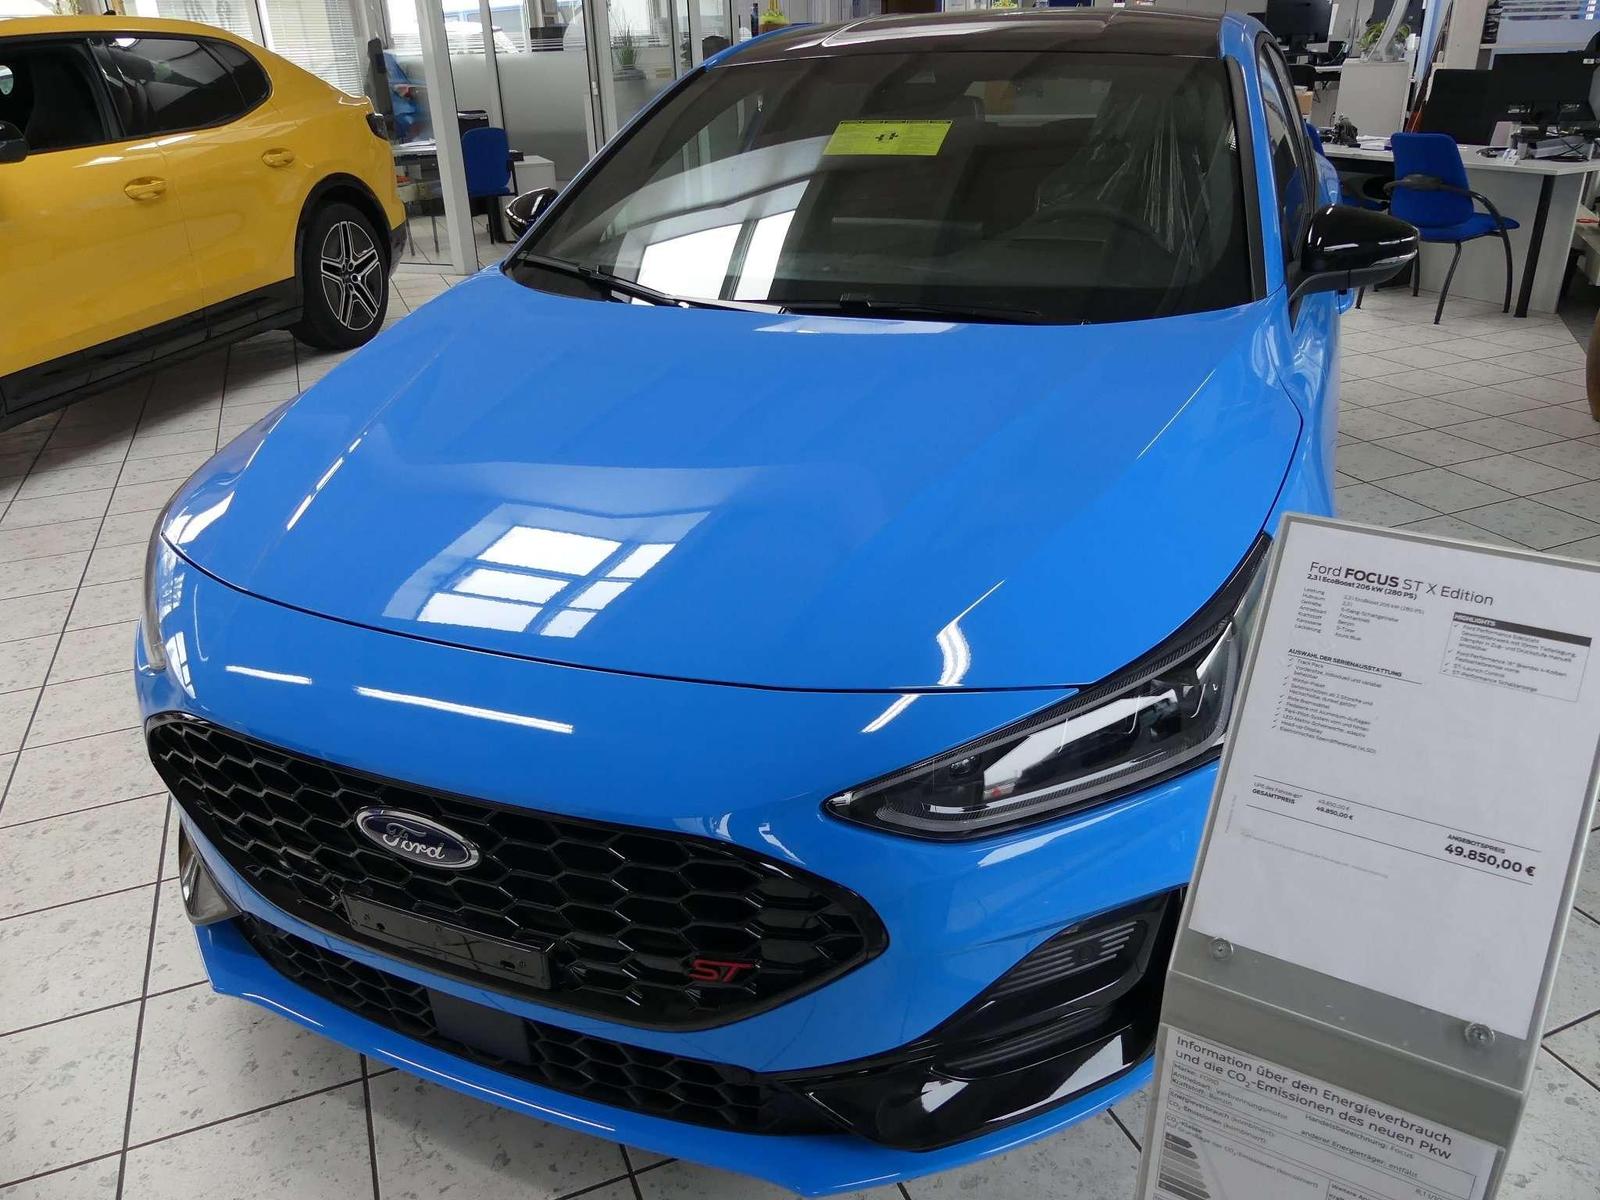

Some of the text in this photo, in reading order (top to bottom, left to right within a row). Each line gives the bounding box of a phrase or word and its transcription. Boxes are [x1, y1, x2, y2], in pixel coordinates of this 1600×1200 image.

[1303, 587, 1325, 595] Leistung
[1309, 562, 1494, 604] Ford FOCUS ST X Edition
[1321, 576, 1355, 588] EcoBoost
[1356, 583, 1371, 591] 206
[1371, 585, 1383, 593] kW
[1384, 588, 1402, 596] (280
[1403, 591, 1417, 599] PS)
[1454, 614, 1496, 626] HIGHLIGHTS
[1288, 649, 1318, 659] AUSWAHL
[1332, 658, 1402, 677] SERIENAUSSTATTUNG
[1251, 788, 1295, 804] GESAMTPREIS
[1315, 806, 1348, 819] 49.850,00
[382, 822, 445, 860] Ford
[1447, 834, 1505, 853] ANGEBOTSPREIS
[1444, 843, 1536, 877] 49.850,00 €
[687, 958, 754, 985] ST
[1176, 1036, 1452, 1145] Information über den Energieverbrauch
[1175, 1050, 1199, 1065] und
[1203, 1060, 1223, 1074] die
[1338, 1110, 1364, 1126] des
[1368, 1122, 1414, 1145] neuen
[1419, 1140, 1451, 1160] Pkw
